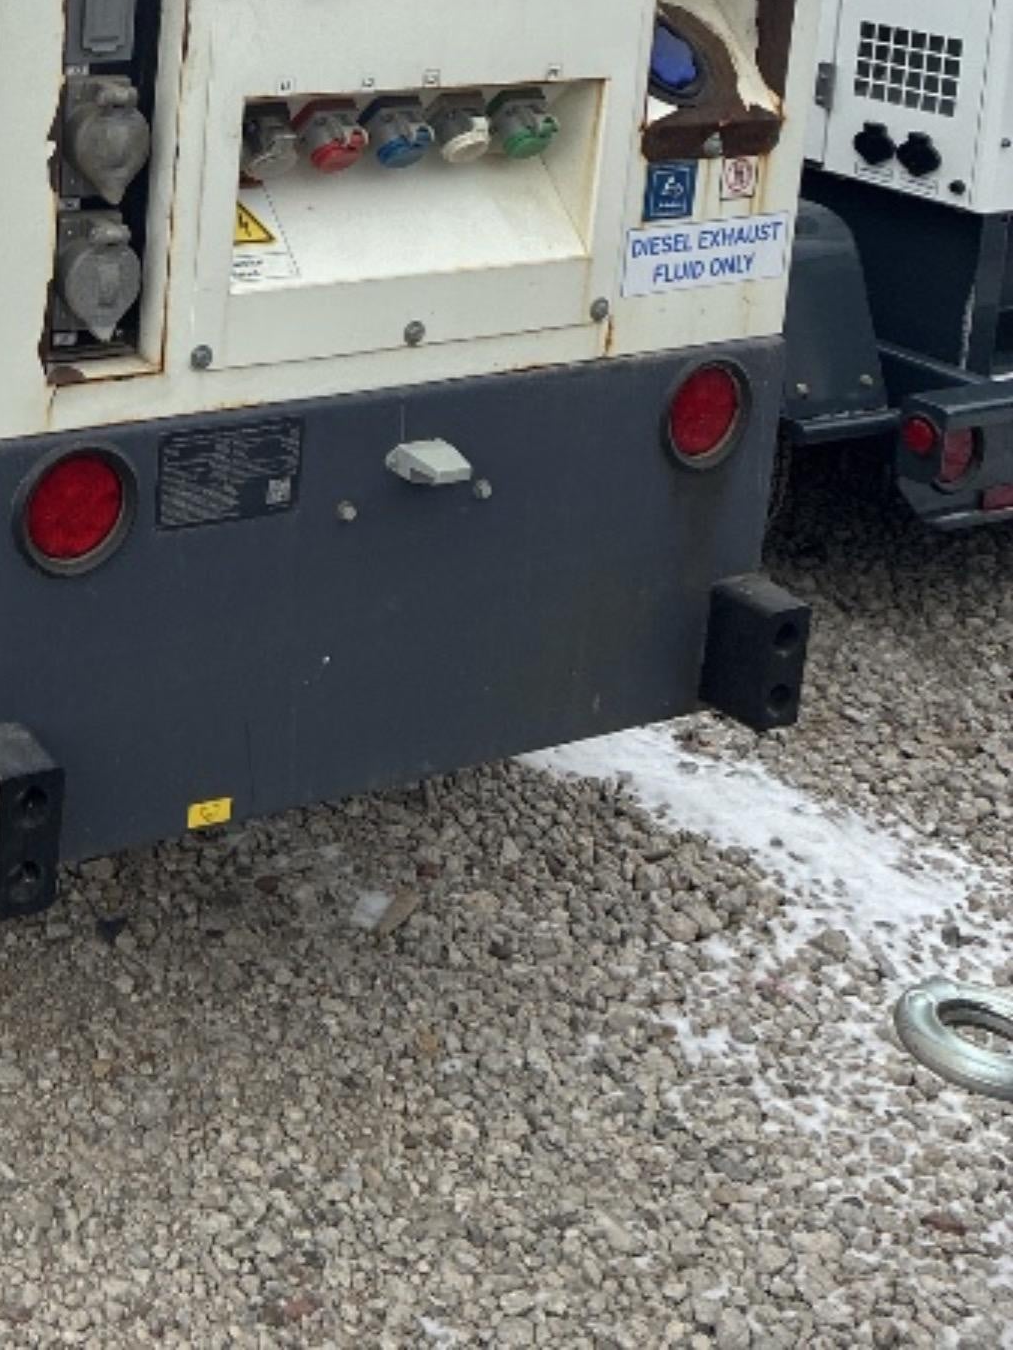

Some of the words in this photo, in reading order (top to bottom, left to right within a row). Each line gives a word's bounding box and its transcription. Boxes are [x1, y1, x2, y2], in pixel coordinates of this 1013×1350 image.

[631, 233, 692, 258] DIESEL
[698, 221, 783, 250] EXHAUST
[652, 259, 705, 285] FLUID
[710, 252, 756, 277] ONLY
